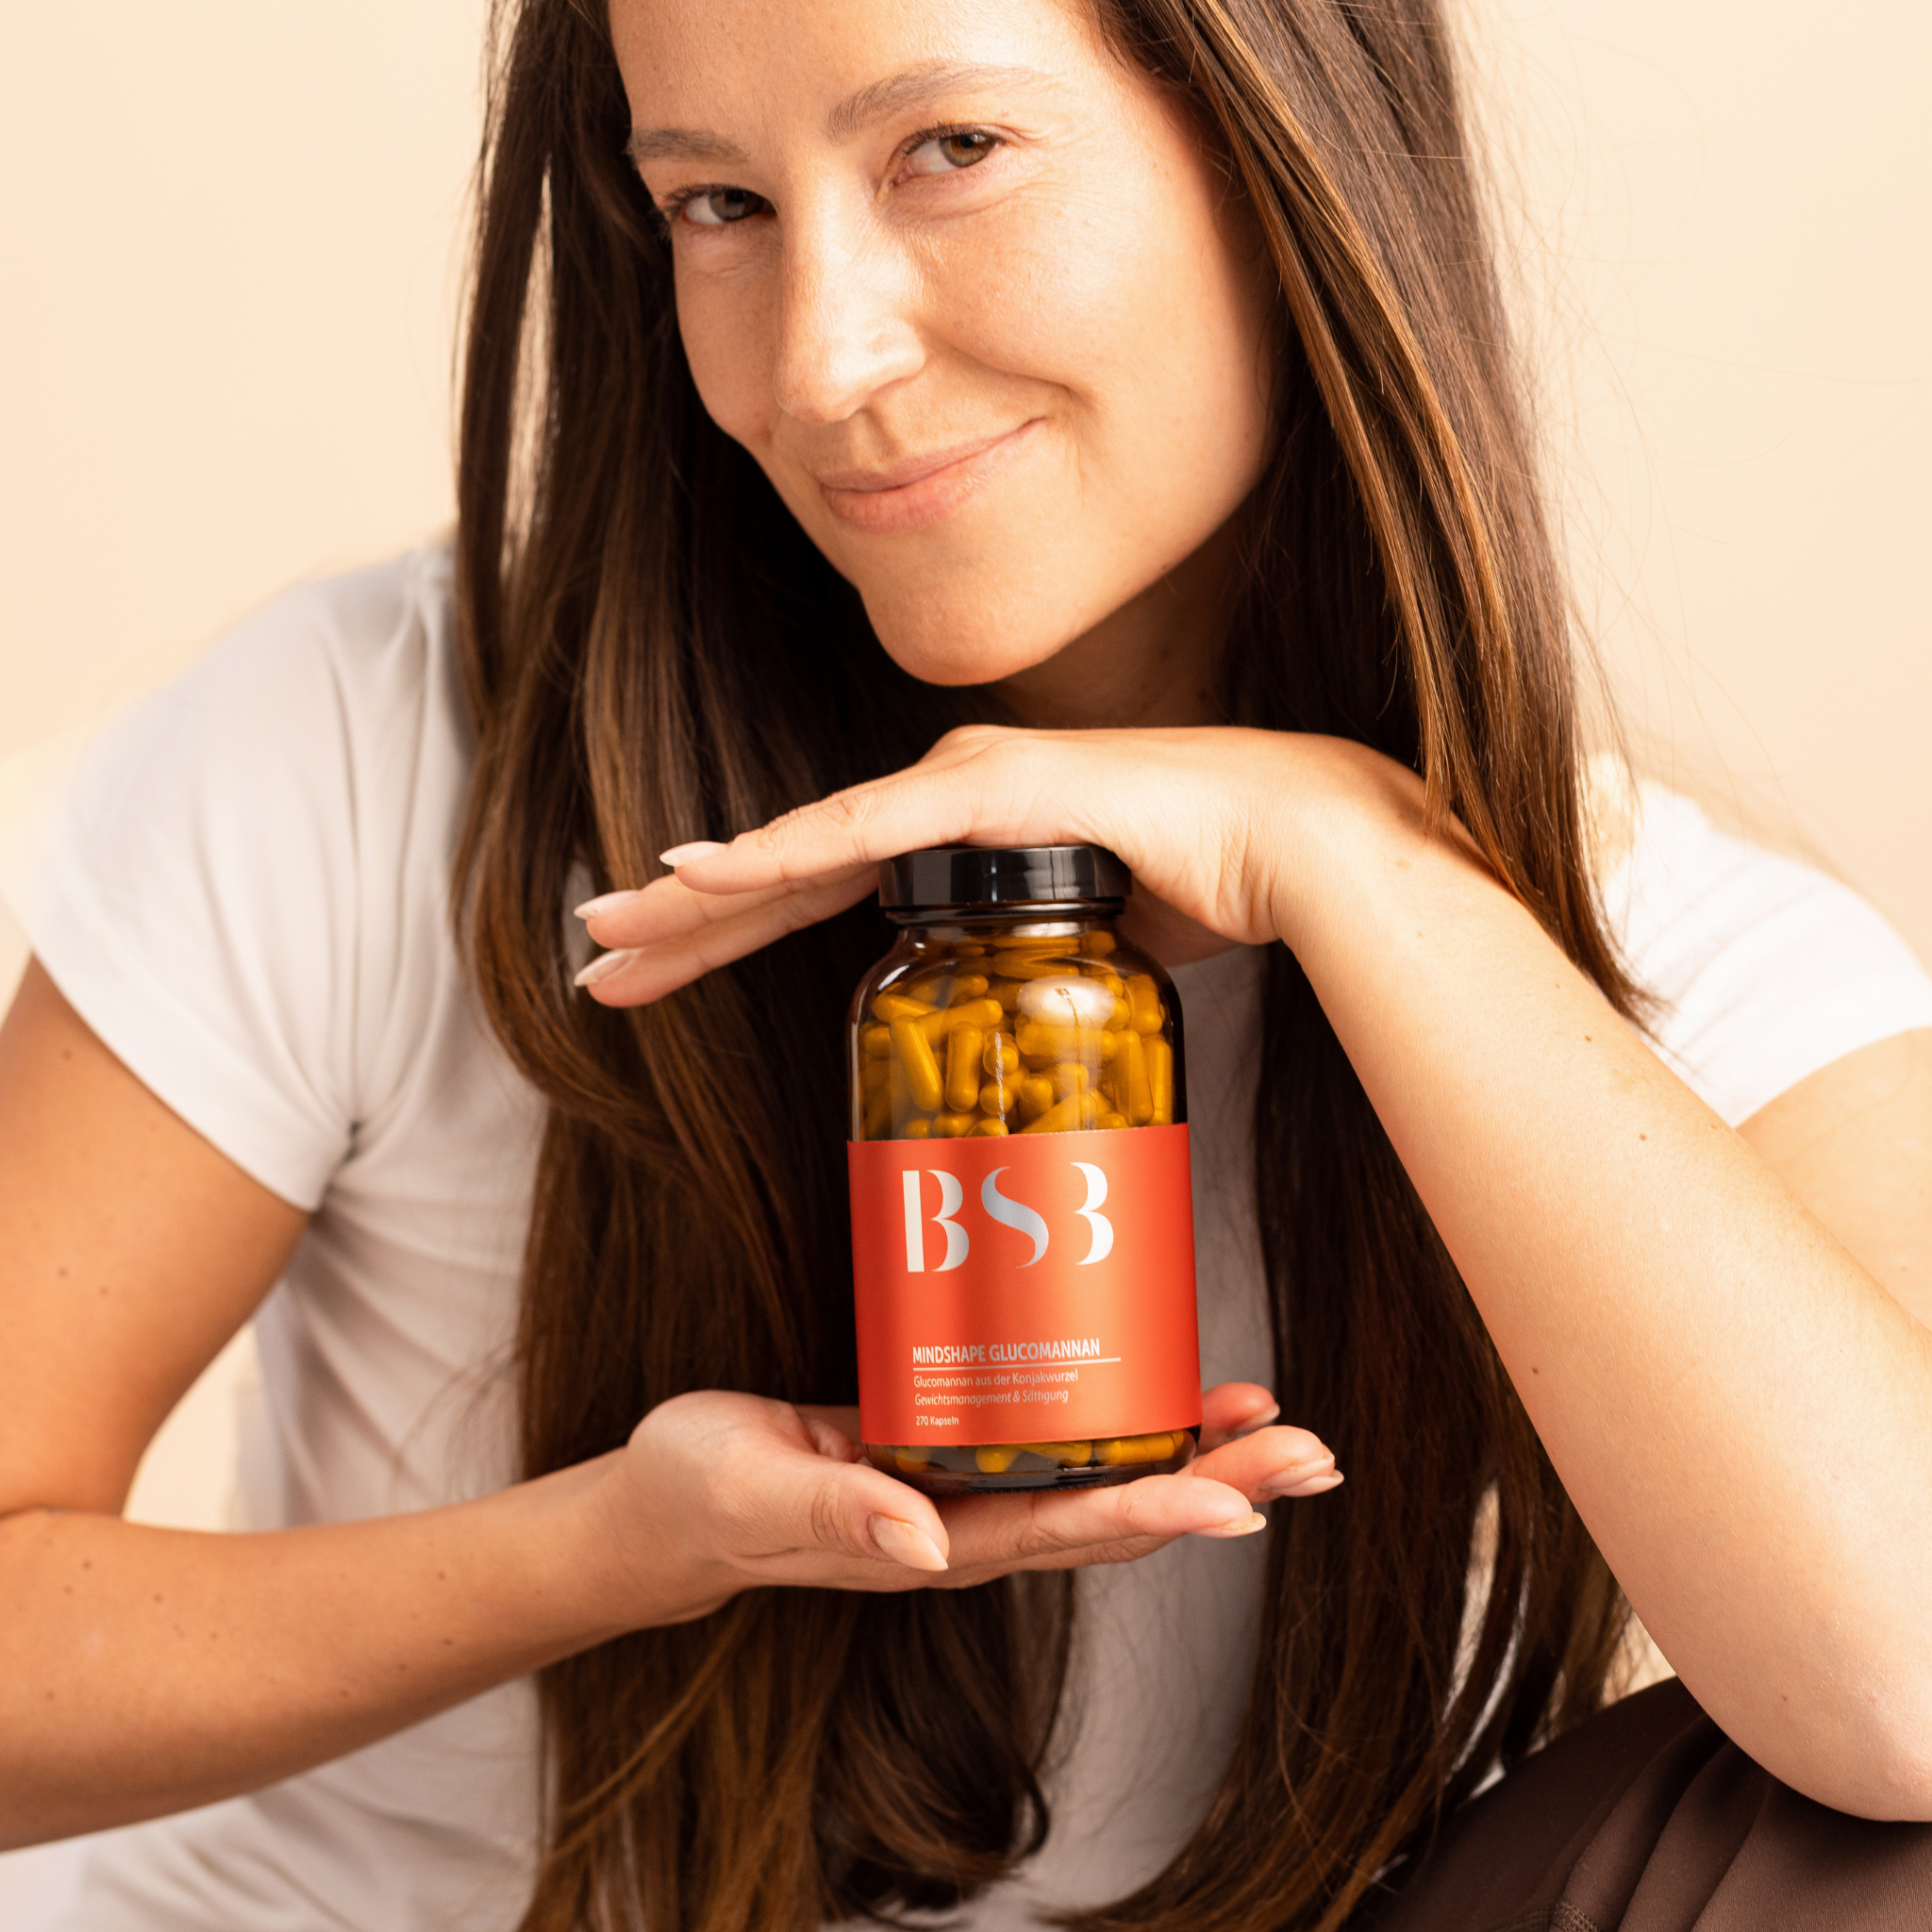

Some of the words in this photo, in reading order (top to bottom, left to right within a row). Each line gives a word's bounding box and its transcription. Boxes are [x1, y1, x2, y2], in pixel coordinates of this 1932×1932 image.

[912, 1344, 987, 1364] MINDSHAPE
[989, 1338, 1101, 1361] GLUCOMANNAN
[913, 1374, 974, 1389] Glucomannan
[974, 1375, 992, 1387] aus
[993, 1373, 1010, 1386] der
[1012, 1369, 1078, 1387] Konjakwurzel
[914, 1391, 1011, 1408] Gewichtsmanagement
[1012, 1390, 1021, 1404] &
[1022, 1390, 1069, 1406] Sättigung
[915, 1415, 929, 1427] 270
[930, 1414, 959, 1428] Kapseln
